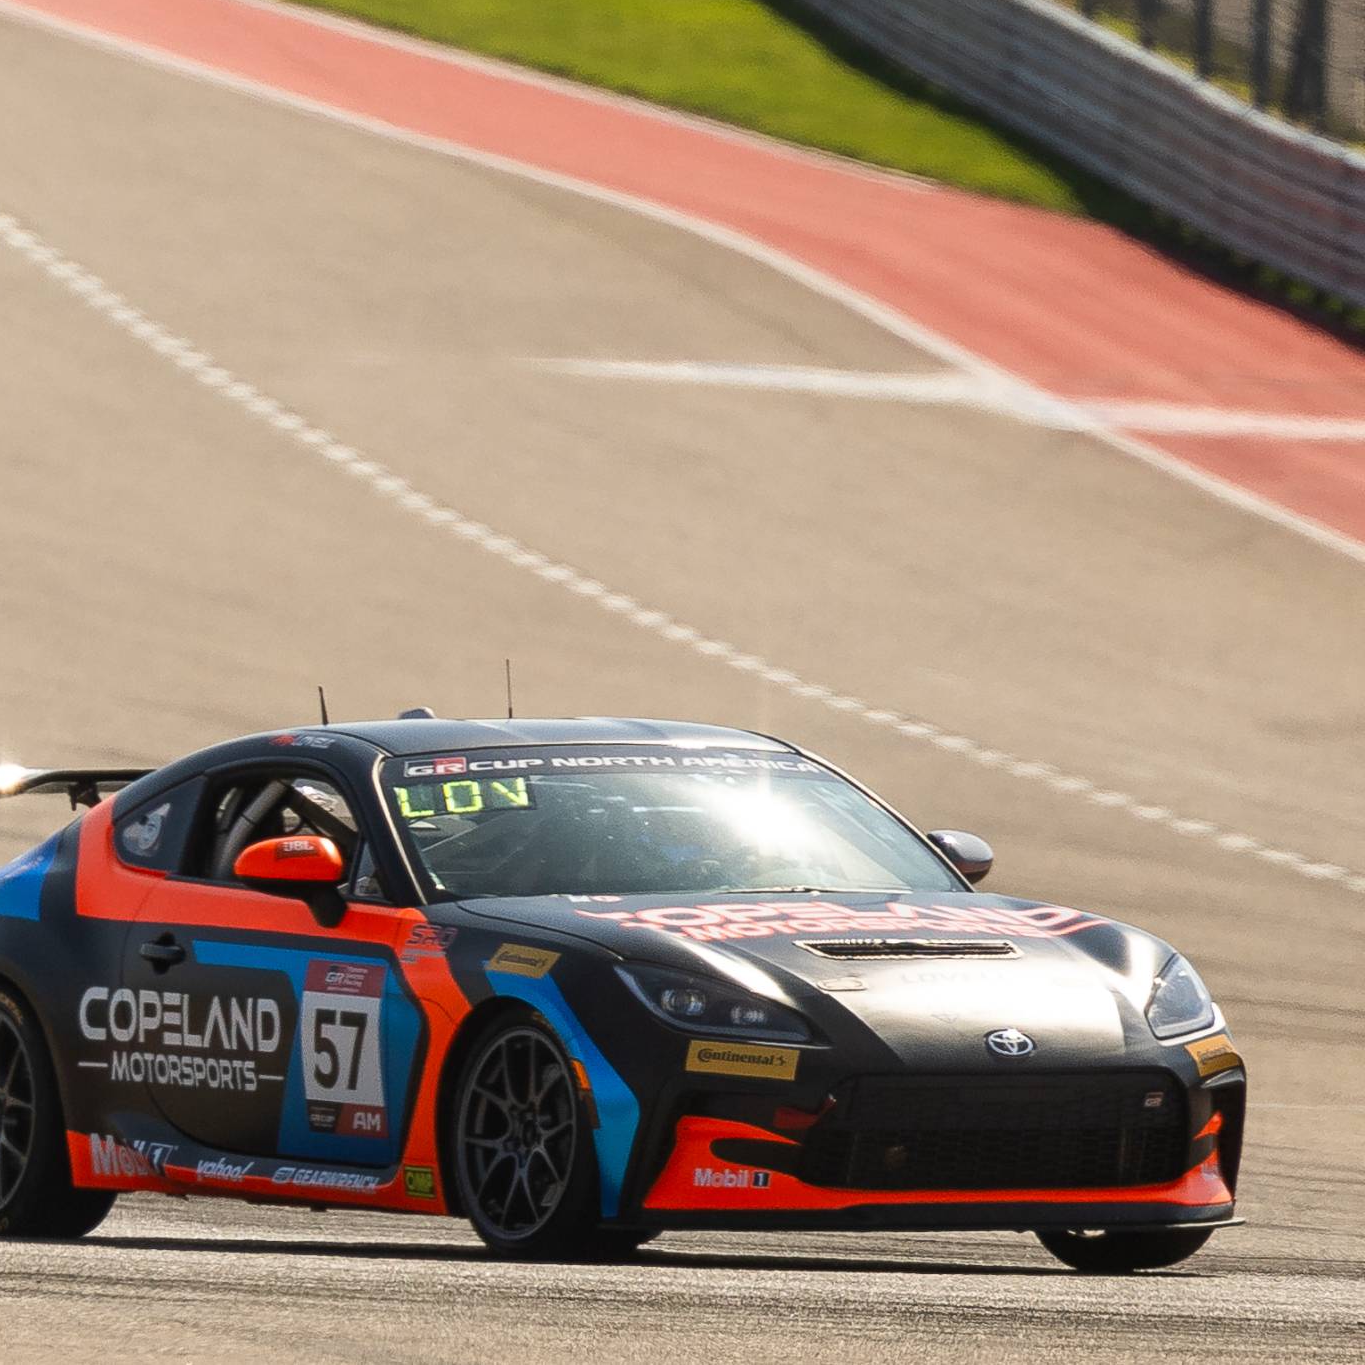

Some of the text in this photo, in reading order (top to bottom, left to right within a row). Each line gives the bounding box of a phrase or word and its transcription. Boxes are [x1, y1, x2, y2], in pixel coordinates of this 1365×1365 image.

[406, 755, 822, 775] GR CUP NORTH AMERICA
[394, 777, 529, 818] LOV
[79, 986, 281, 1053] COPELAND
[314, 1008, 368, 1091] 57
[697, 1047, 775, 1066] Continental
[111, 1050, 258, 1092] MOTORSPORTS
[352, 1111, 382, 1132] AM
[195, 1157, 382, 1195] yahoo! GEARWRENCH
[693, 1167, 769, 1188] Mobil 1
